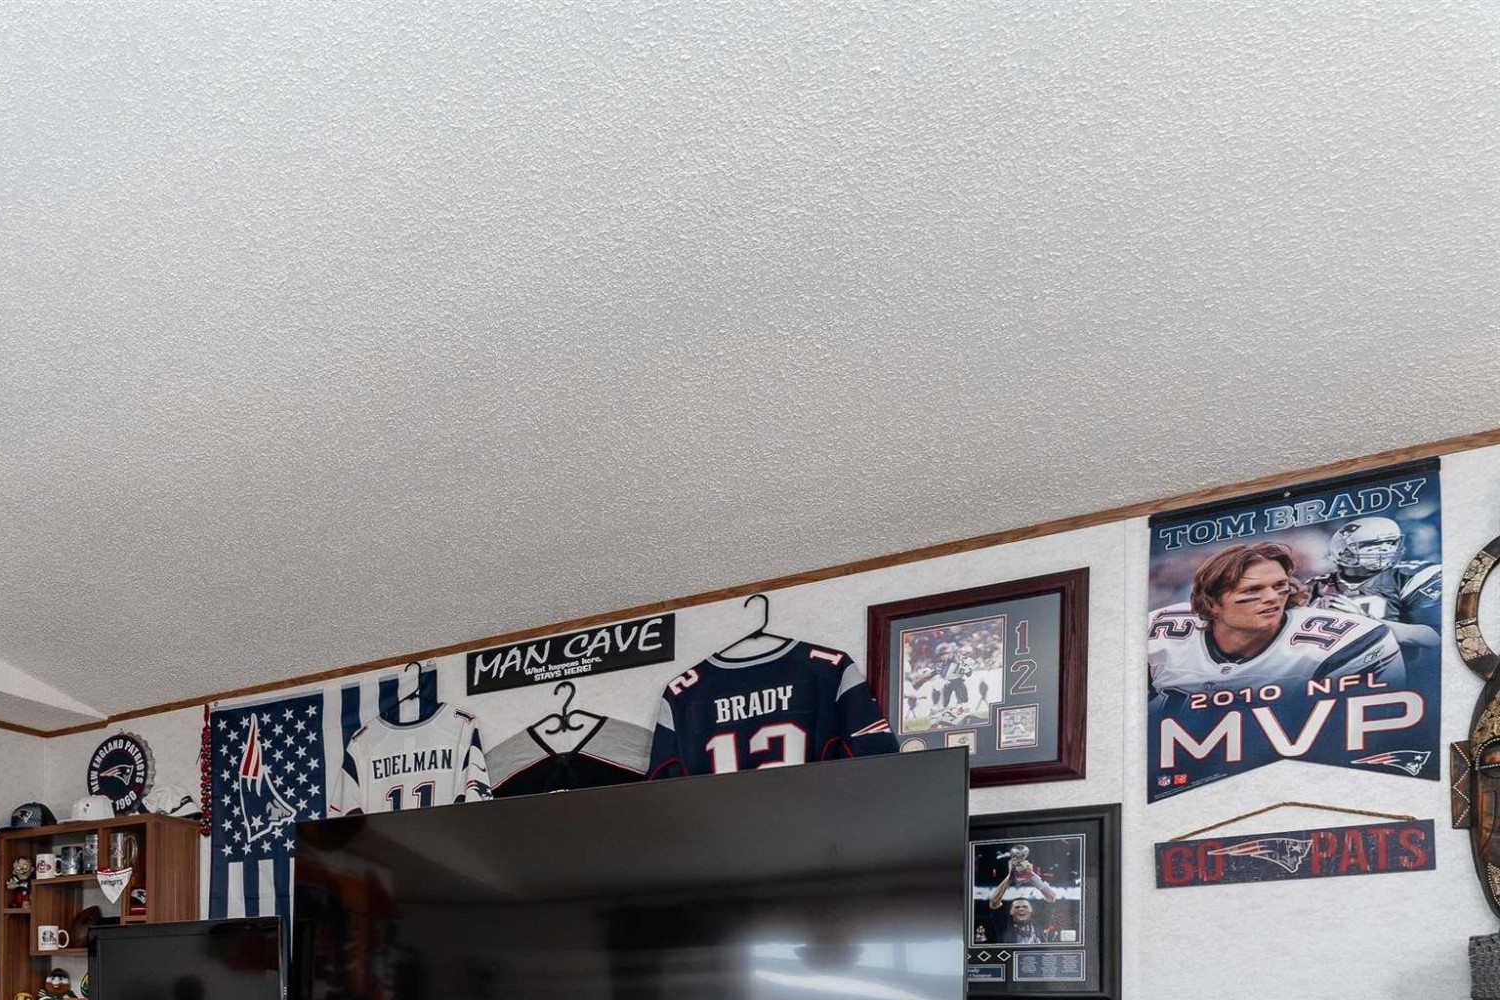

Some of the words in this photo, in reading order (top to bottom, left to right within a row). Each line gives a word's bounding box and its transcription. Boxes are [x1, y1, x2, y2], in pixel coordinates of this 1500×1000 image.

[1160, 512, 1256, 550] TOM
[1264, 478, 1427, 532] BRADY
[474, 640, 550, 686] MAN
[563, 618, 663, 658] CAVE
[1015, 620, 1029, 655] 1
[524, 666, 546, 675] What
[548, 660, 579, 671] happens
[534, 670, 561, 681] STAYS
[564, 664, 592, 676] HERE!
[1010, 659, 1037, 695] 2
[714, 685, 793, 723] BRADY
[1190, 684, 1282, 709] 2010
[1307, 672, 1388, 696] NFL
[1159, 690, 1425, 769] MVP
[92, 739, 124, 768] ENGLAND
[124, 740, 145, 784] PATRIOTS
[372, 749, 452, 779] EDELMAN
[90, 770, 100, 793] NEW
[115, 790, 137, 810] 1960
[1161, 839, 1226, 885] GO
[1309, 827, 1429, 875] PATS
